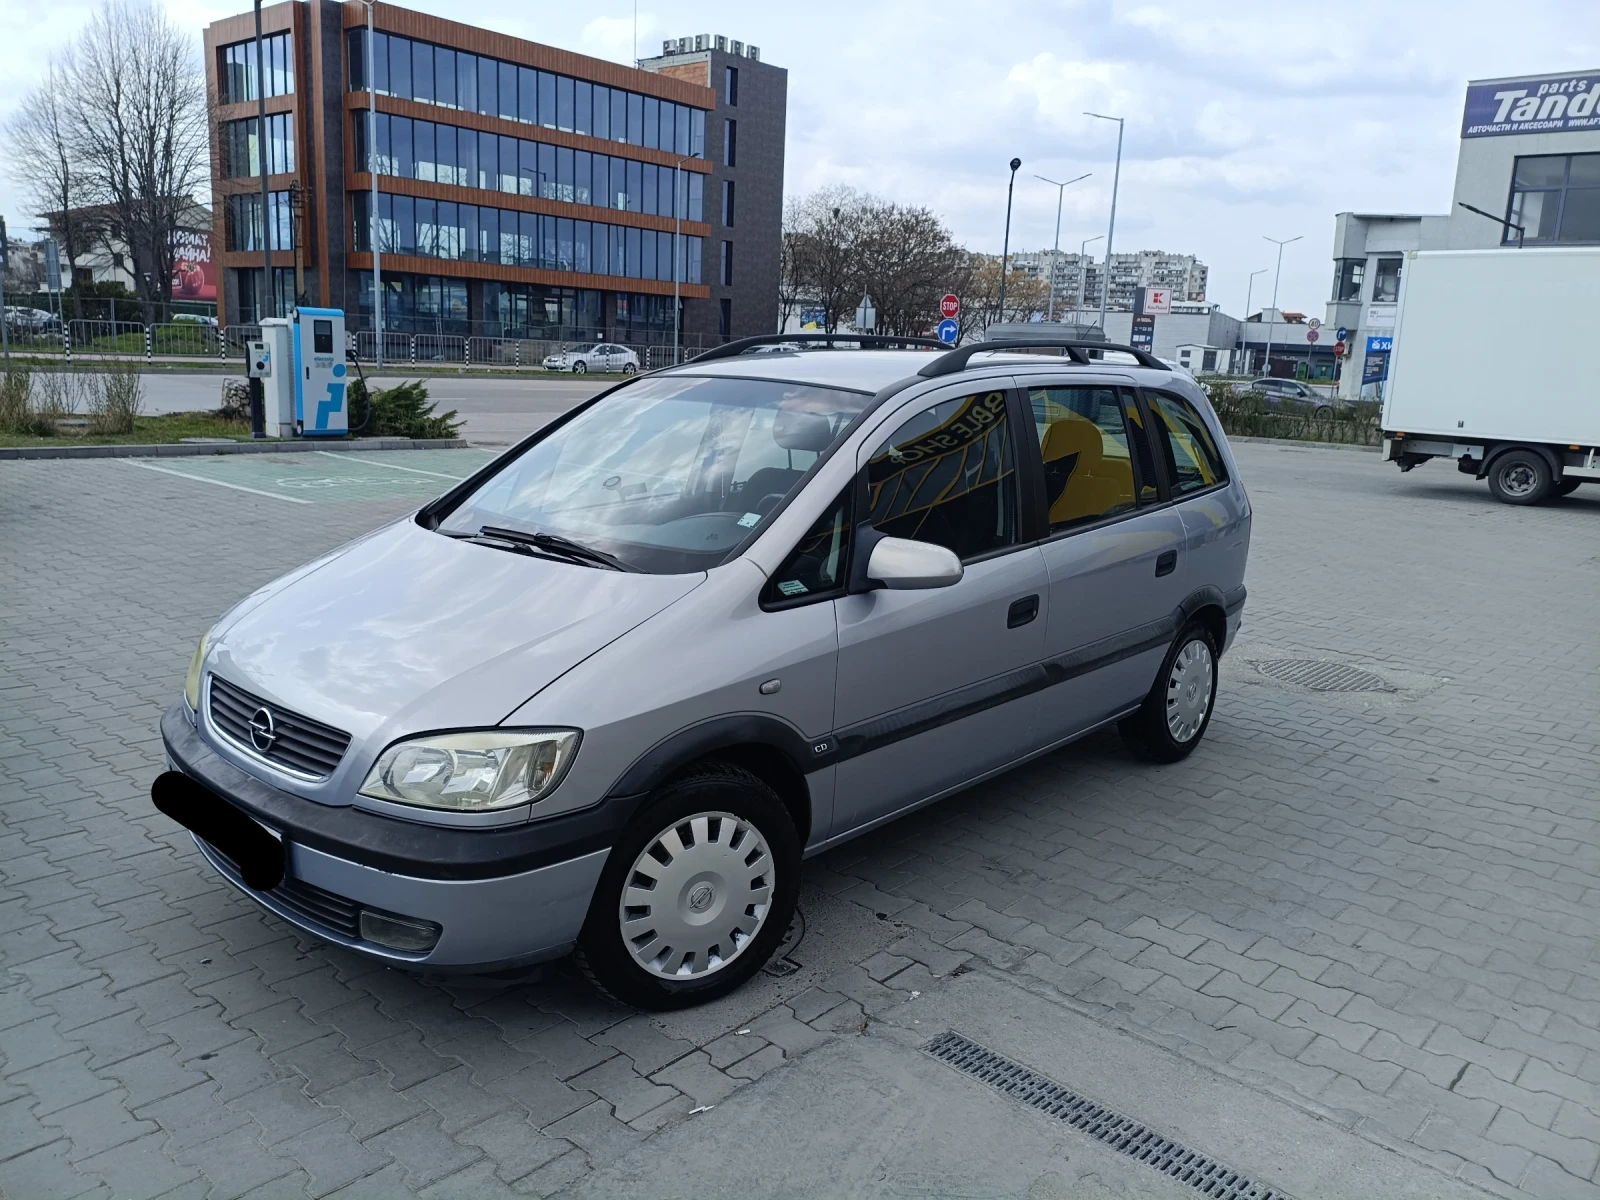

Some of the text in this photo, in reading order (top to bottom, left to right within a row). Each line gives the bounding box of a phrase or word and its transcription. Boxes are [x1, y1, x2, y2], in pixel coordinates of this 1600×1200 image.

[1537, 79, 1588, 97] parts
[1492, 83, 1600, 123] Tand
[1467, 123, 1511, 134] АВТОЧАСТИ
[1519, 119, 1564, 130] АКСЕСОАРИ
[942, 301, 958, 311] STOP
[814, 743, 828, 753] CD
